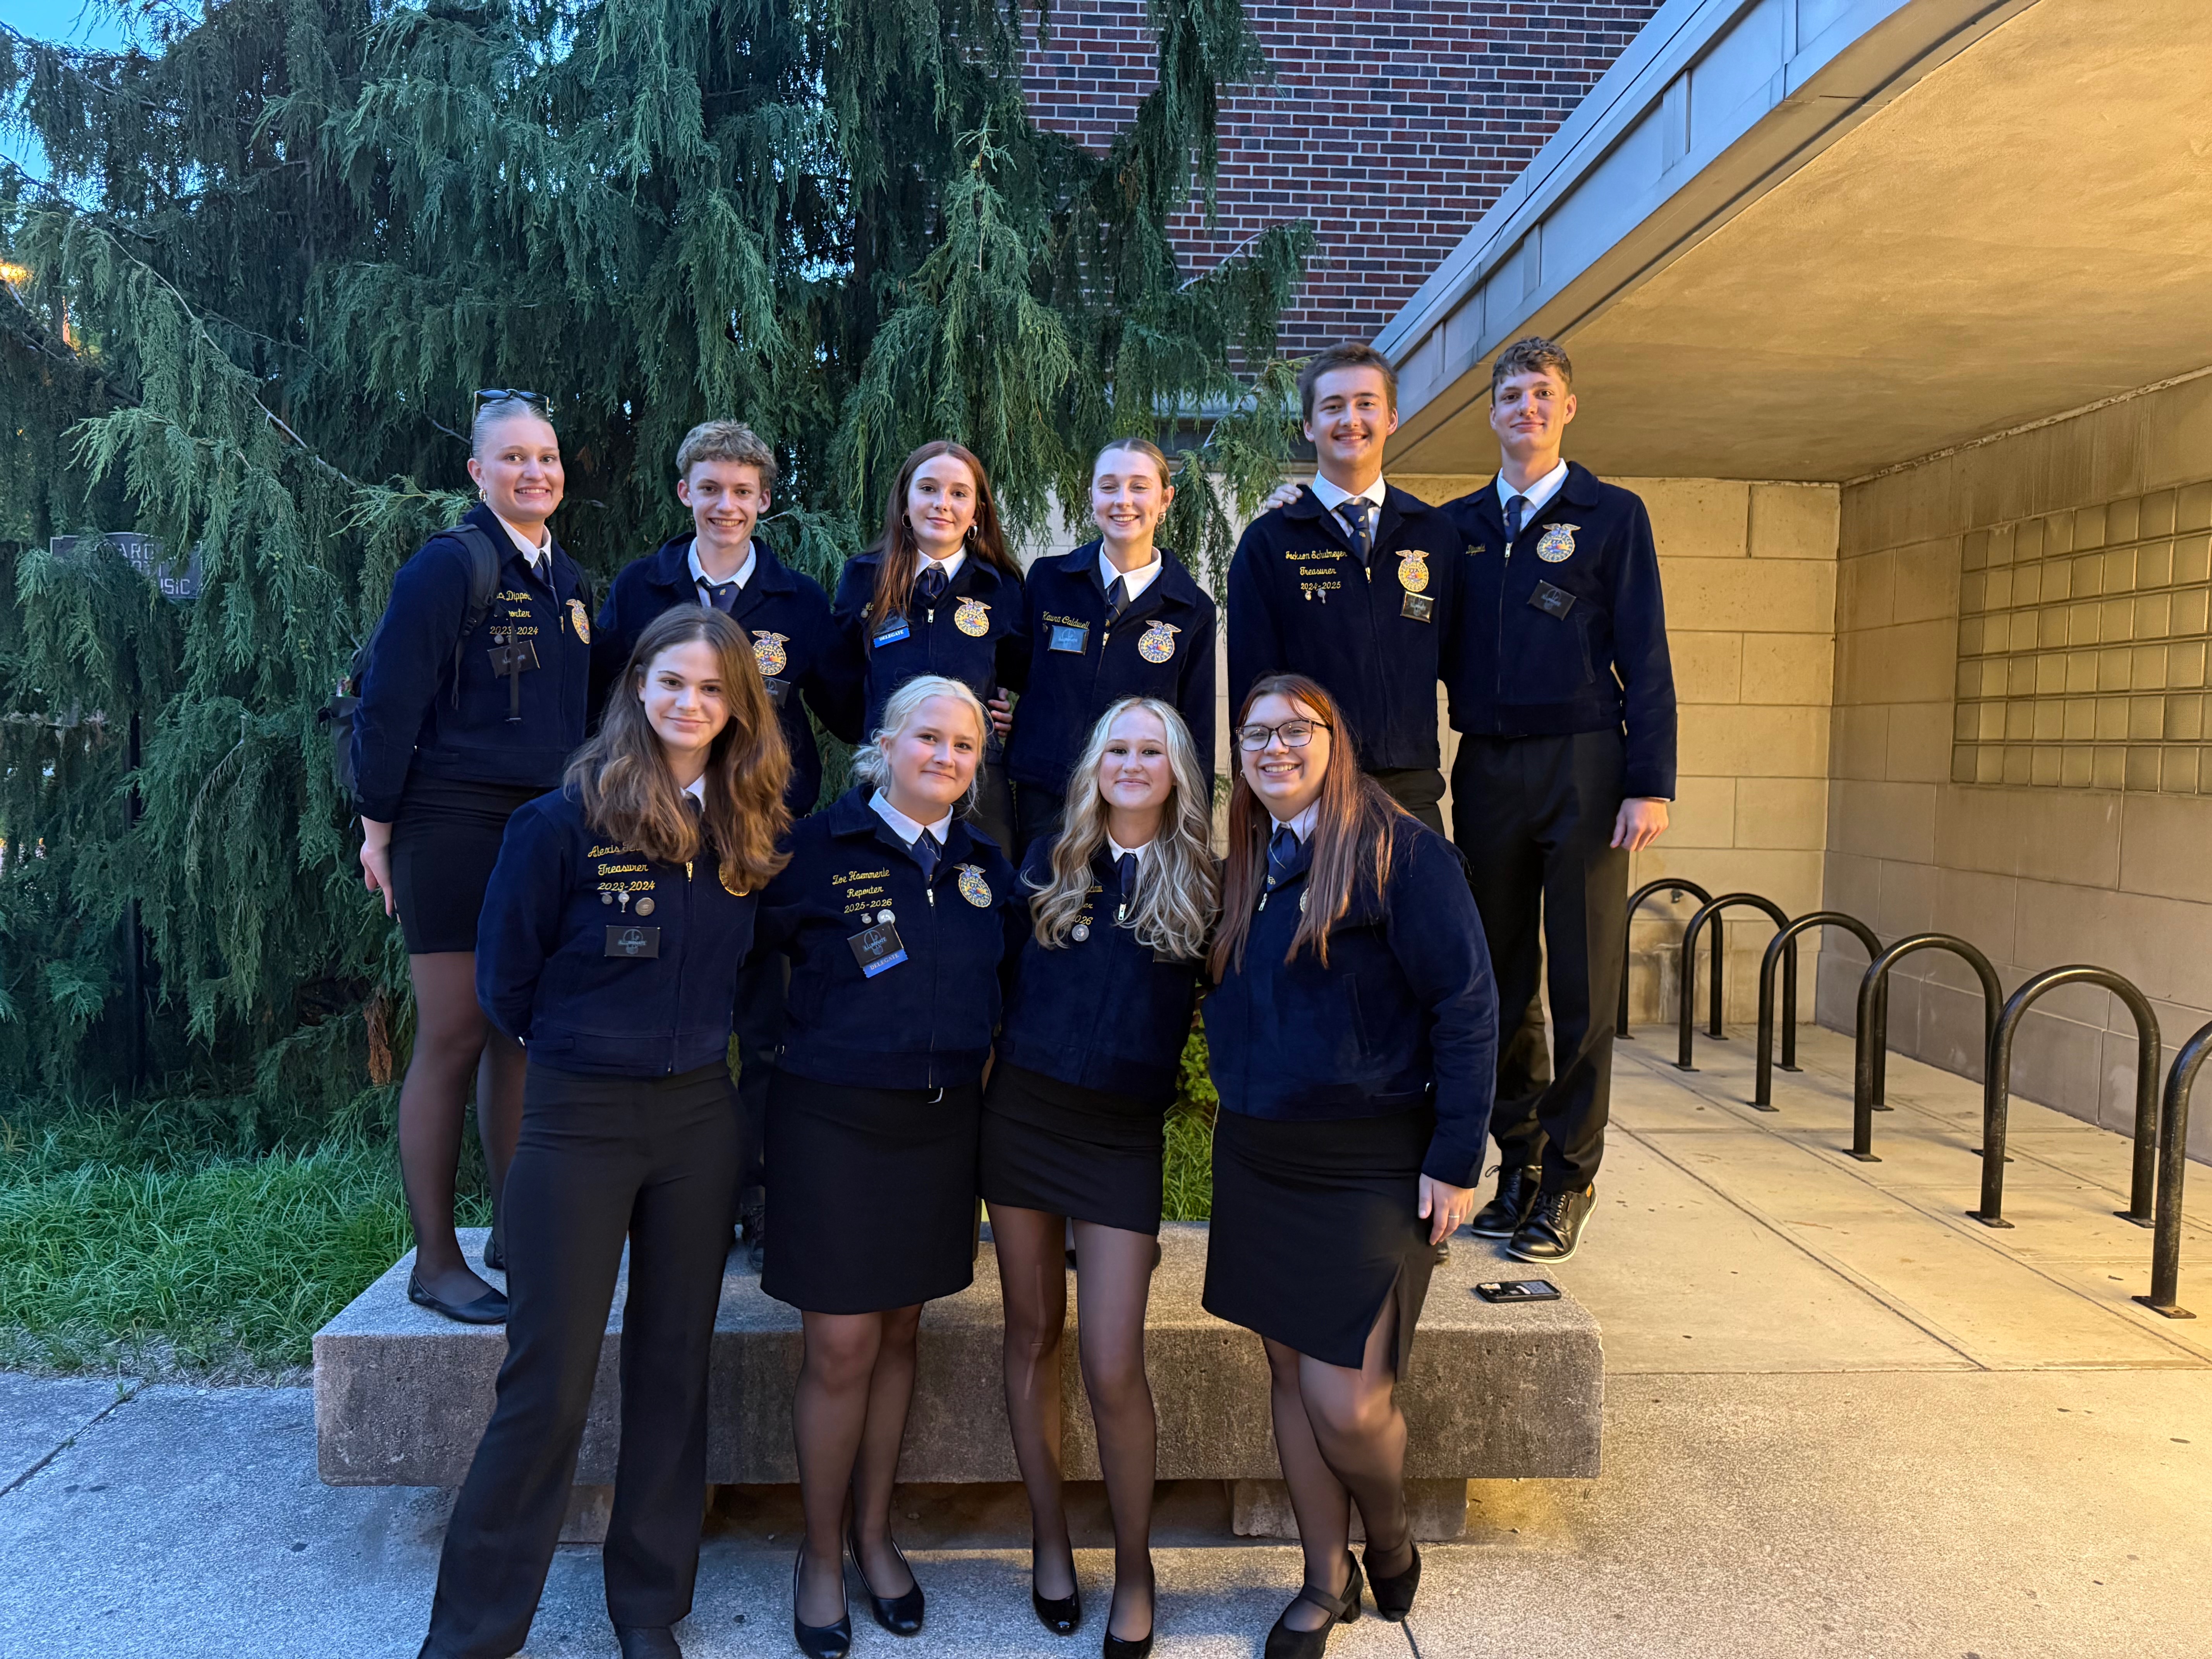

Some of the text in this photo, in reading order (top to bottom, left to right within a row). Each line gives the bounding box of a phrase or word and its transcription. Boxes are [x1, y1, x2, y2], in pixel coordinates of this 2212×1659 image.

[1300, 566, 1337, 576] Treasurer
[1300, 581, 1341, 591] 2024-2025
[1061, 616, 1090, 629] Caldwell
[489, 626, 539, 635] 20232024
[879, 629, 904, 641] DELEGATE
[587, 845, 620, 857] Alexis
[598, 864, 649, 876] Treasurer
[832, 874, 847, 885] Zoe
[597, 880, 656, 892] 2023-2024
[847, 885, 884, 899] Reporter
[844, 898, 892, 914] 2025-2026
[869, 953, 899, 970] DELEGATE
